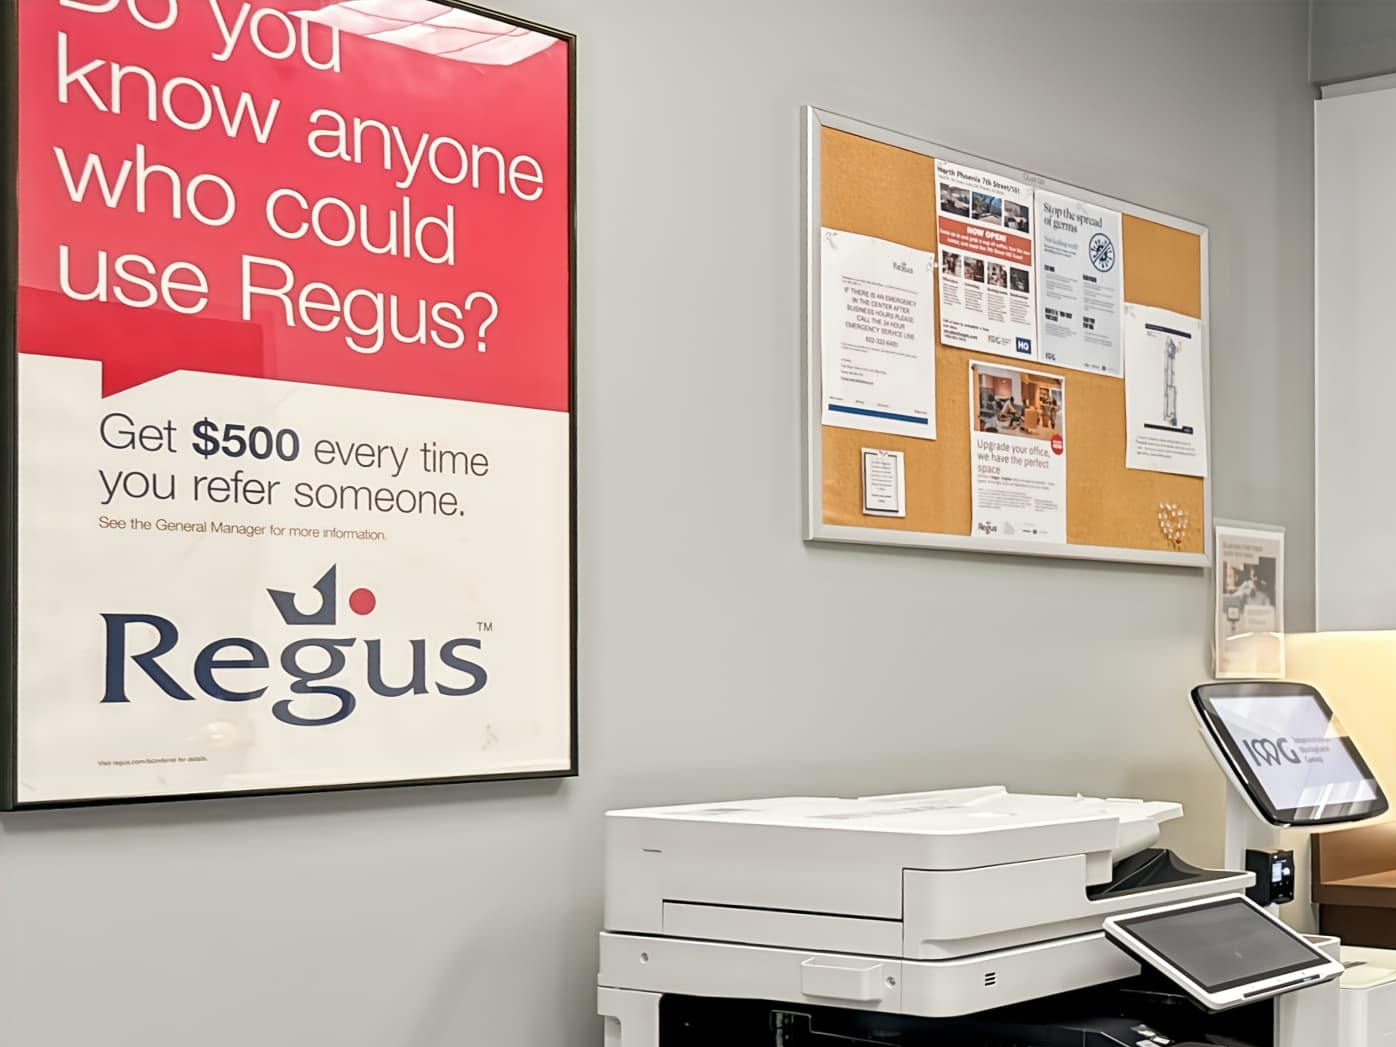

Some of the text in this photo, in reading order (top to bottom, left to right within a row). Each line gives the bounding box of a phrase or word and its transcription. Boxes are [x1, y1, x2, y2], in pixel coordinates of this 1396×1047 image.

[210, 0, 341, 73] you
[58, 32, 544, 201] know anyone
[53, 144, 456, 266] who could
[1043, 202, 1103, 228] Stop the spread
[1044, 216, 1078, 232] of germs
[58, 244, 498, 354] use Regus?
[851, 287, 869, 297] THERE
[885, 295, 917, 307] EMERGENCY
[871, 301, 892, 309] CENTER
[893, 305, 910, 313] AFTER
[847, 303, 914, 323] BUSINESS HOURS PLEASE
[856, 314, 870, 323] CALL
[872, 317, 881, 325] THE
[890, 321, 905, 329] HOUR
[845, 321, 880, 333] EMERGENCY
[881, 328, 903, 338] SERVICE
[100, 413, 490, 478] Get $500 every time
[977, 439, 1051, 458] Upgrade your office,
[977, 452, 1049, 469] we have the perfect
[978, 464, 1001, 475] space
[99, 469, 466, 517] you refer someone.
[98, 516, 388, 542] See the General Manager for more information.
[100, 612, 488, 727] Regus
